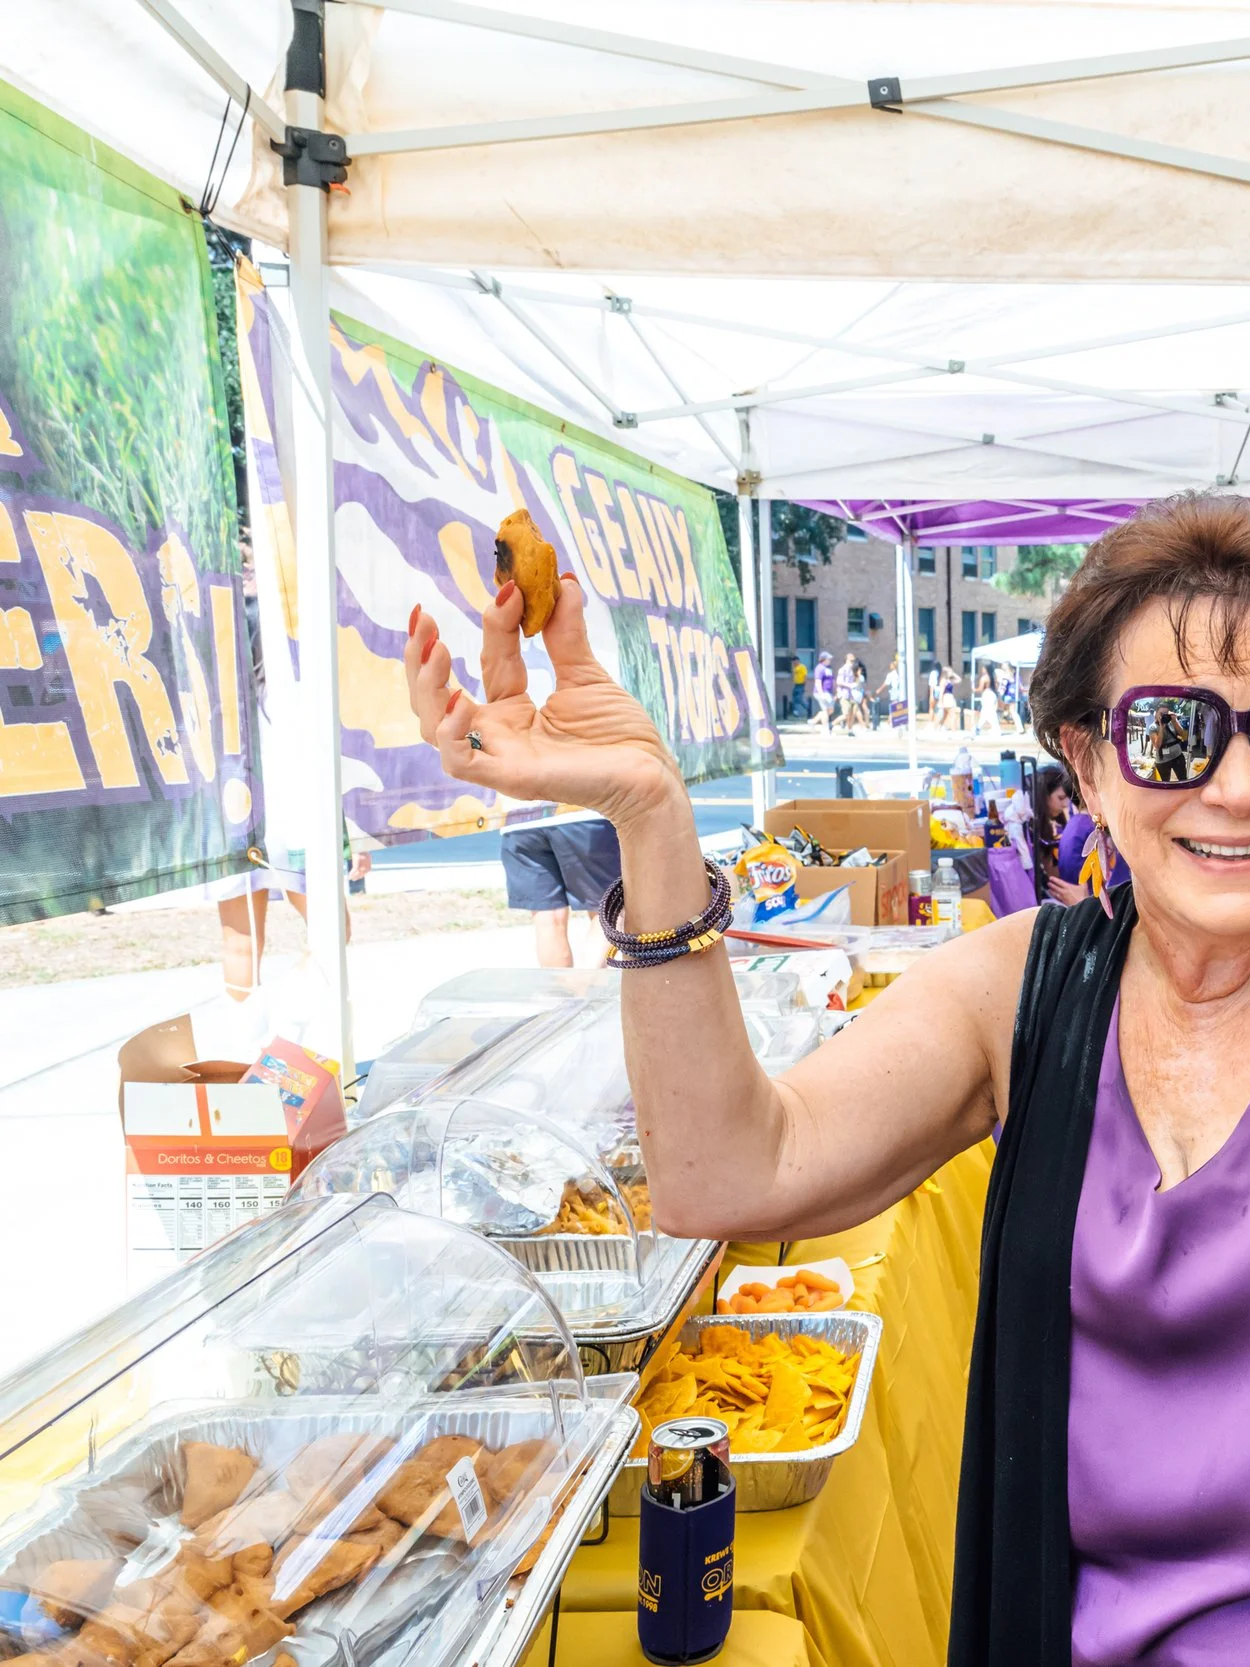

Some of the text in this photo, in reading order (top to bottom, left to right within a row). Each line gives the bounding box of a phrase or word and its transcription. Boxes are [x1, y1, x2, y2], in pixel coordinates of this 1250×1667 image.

[552, 453, 704, 616] GEAUX
[747, 862, 792, 889] Fritos
[158, 1153, 267, 1165] Doritos & Cheetos
[241, 1200, 259, 1208] 150
[270, 1200, 285, 1208] 15
